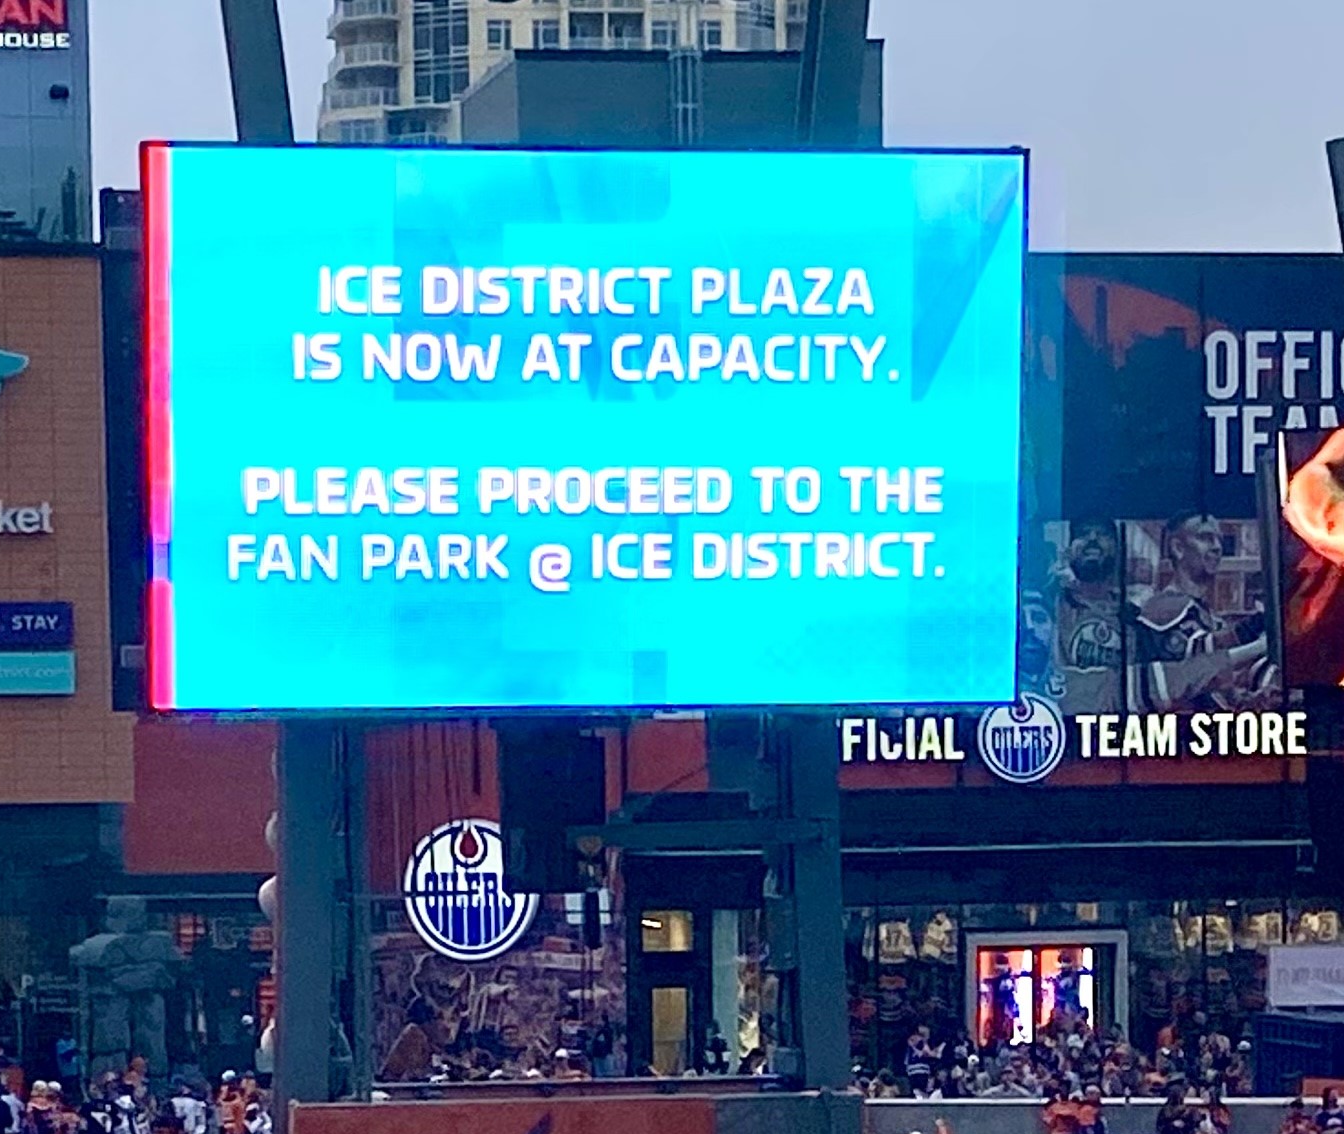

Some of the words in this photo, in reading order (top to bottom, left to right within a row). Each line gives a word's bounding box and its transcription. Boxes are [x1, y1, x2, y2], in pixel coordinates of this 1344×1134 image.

[317, 266, 402, 315] ICE
[421, 266, 671, 315] DISTRICT
[690, 267, 874, 315] PLAZA
[292, 334, 342, 382] IS
[362, 334, 501, 382] NOW
[522, 334, 591, 381] AT
[611, 334, 899, 382] CAPACITY.
[241, 467, 459, 515] PLEASE
[477, 467, 732, 514] PROCEED
[750, 467, 822, 513] TO
[839, 467, 944, 513] THE
[227, 533, 338, 581] FAN
[361, 533, 508, 580] PARK
[529, 544, 573, 592] @
[591, 533, 672, 579] ICE
[692, 533, 945, 579] DISTRICT.
[11, 615, 59, 631] STAY
[838, 716, 965, 762] FICIAL
[1076, 713, 1177, 758] TEAM
[1189, 711, 1307, 757] STORE
